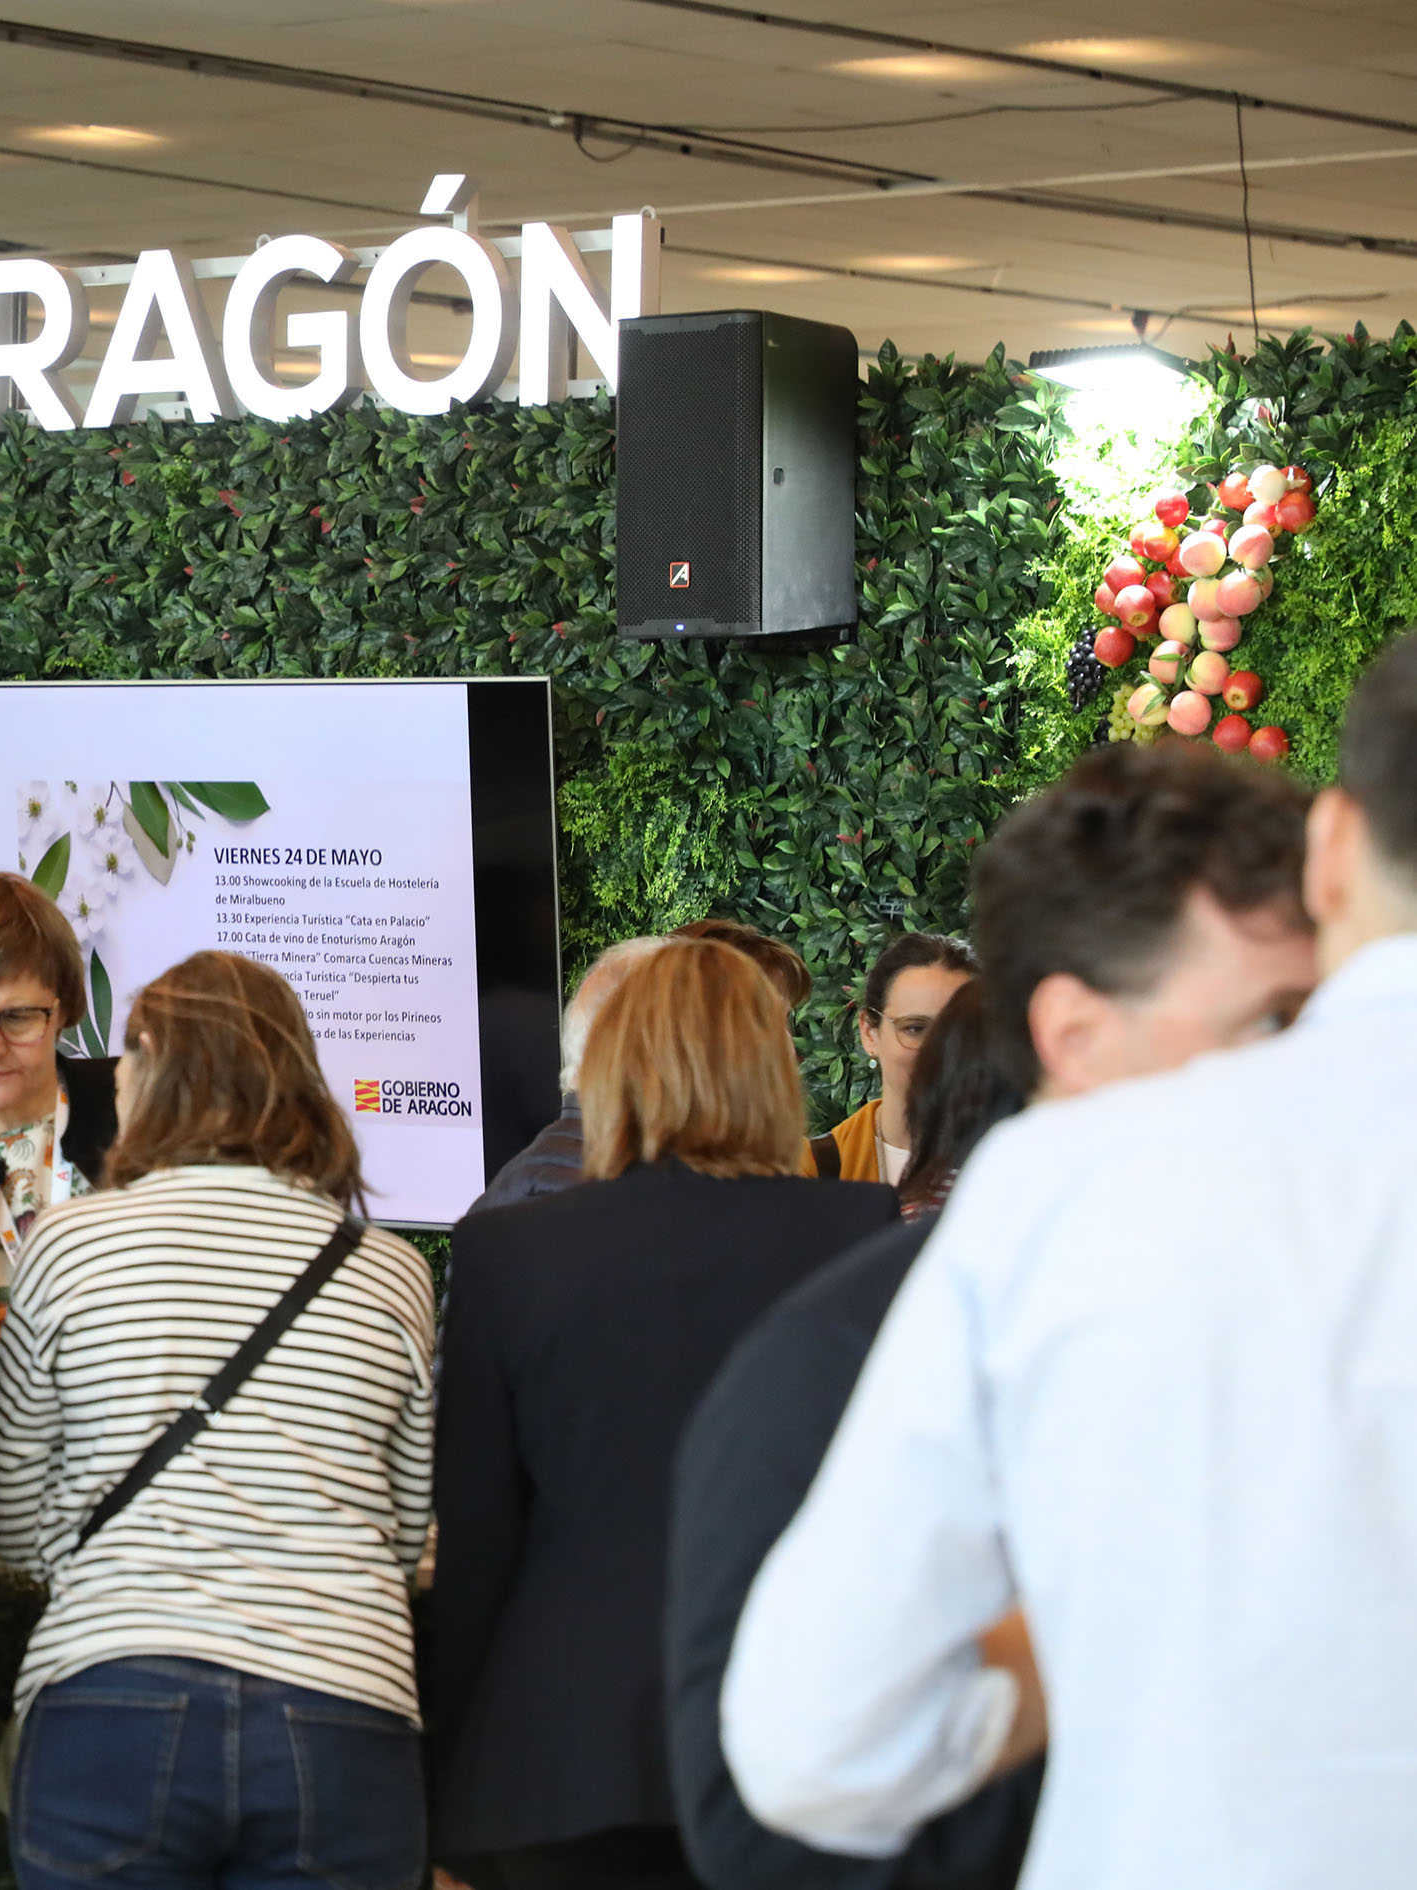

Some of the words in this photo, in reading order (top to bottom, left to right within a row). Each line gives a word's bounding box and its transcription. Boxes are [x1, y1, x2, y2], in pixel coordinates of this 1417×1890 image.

[214, 847, 280, 865] VIERNES
[285, 848, 303, 865] 24
[306, 848, 327, 865] DE
[332, 849, 382, 866] MAYO
[216, 875, 241, 886] 13.00
[243, 876, 306, 889] Showcooking
[309, 876, 321, 887] de
[324, 876, 332, 887] la
[335, 877, 371, 888] Escuela
[374, 877, 386, 888] de
[389, 877, 439, 889] Hostelería
[216, 894, 227, 904] de
[230, 894, 285, 905] Miralbueno
[217, 913, 242, 923] 13.30
[245, 913, 299, 926] Experiencia
[302, 914, 342, 925] Turística
[346, 915, 372, 926] “Cata
[375, 918, 387, 926] en
[390, 916, 430, 927] Palacio”
[218, 931, 243, 942] 17.00
[245, 932, 266, 943] Cata
[269, 932, 281, 943] de
[284, 933, 304, 944] vino
[307, 933, 318, 944] de
[322, 934, 377, 945] Enoturismo
[380, 934, 415, 948] Aragón
[282, 952, 320, 963] Minera”
[324, 953, 366, 964] Comarca
[369, 954, 409, 965] Cuencas
[412, 954, 452, 966] Mineras
[305, 971, 346, 982] Turística
[349, 972, 401, 986] “Despierta
[404, 974, 419, 984] tus
[304, 990, 339, 1001] Teruel”
[317, 1009, 330, 1020] sin
[333, 1011, 363, 1021] motor
[366, 1013, 382, 1023] por
[385, 1010, 399, 1022] los
[402, 1011, 441, 1023] Pirineos
[324, 1028, 336, 1039] de
[339, 1028, 352, 1039] las
[355, 1029, 415, 1042] Experiencias
[382, 1080, 460, 1098] GOBIERNO
[382, 1098, 402, 1114] DE
[407, 1098, 472, 1117] ARAGON
